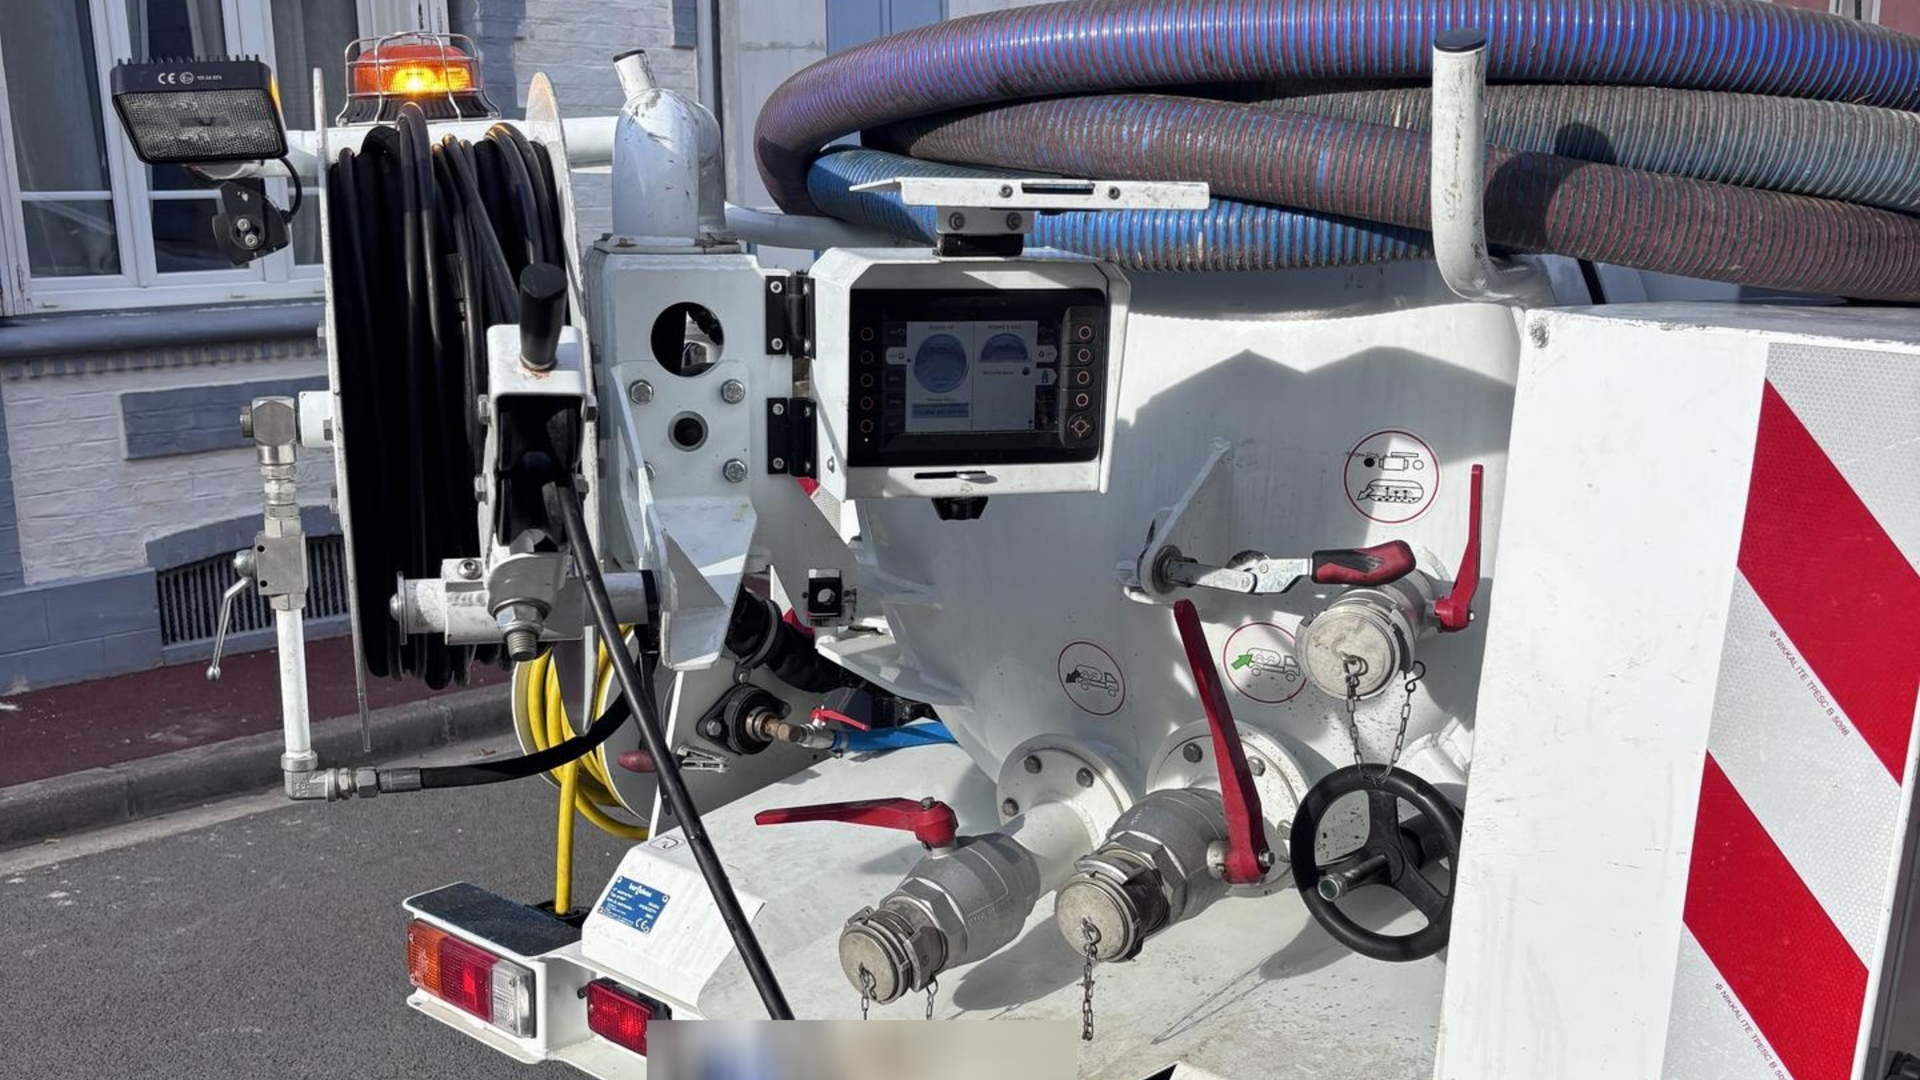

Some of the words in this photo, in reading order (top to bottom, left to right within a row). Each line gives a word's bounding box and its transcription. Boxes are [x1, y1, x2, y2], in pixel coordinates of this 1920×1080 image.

[158, 73, 176, 85] CE
[1774, 637, 1808, 680] NIKKALITE
[1806, 680, 1829, 708] TPESC
[1825, 707, 1834, 716] B
[1718, 990, 1753, 1033] NIKKALITE
[1750, 1033, 1772, 1061] TPESC
[1769, 1060, 1777, 1069] B
